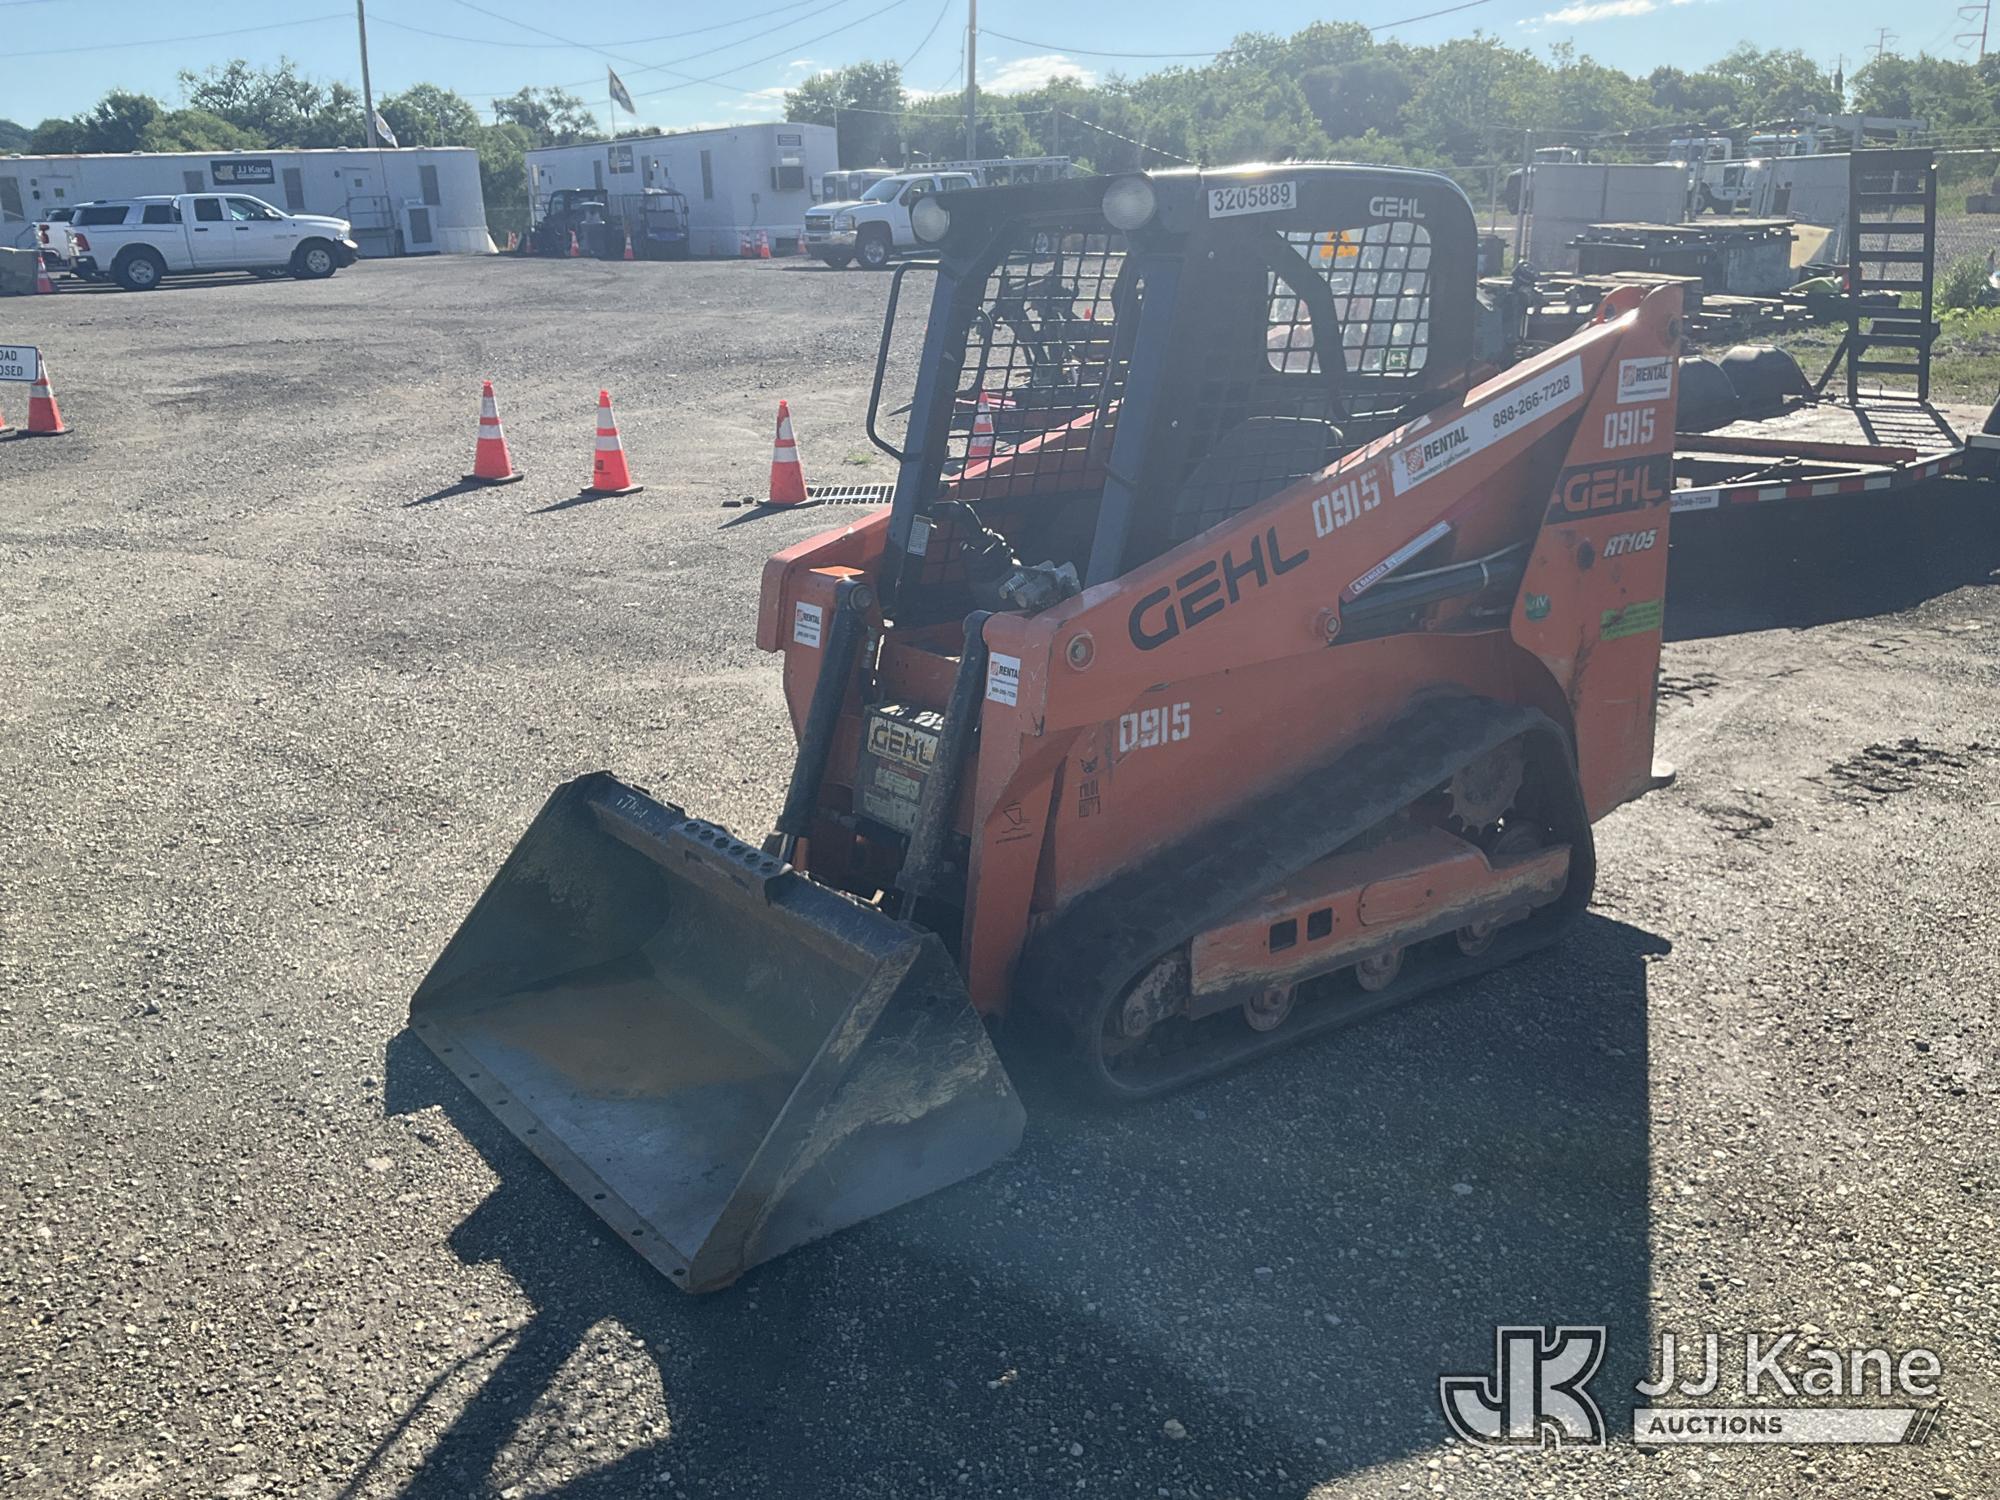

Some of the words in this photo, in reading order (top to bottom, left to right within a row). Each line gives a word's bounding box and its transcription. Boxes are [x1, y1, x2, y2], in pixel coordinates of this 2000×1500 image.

[248, 165, 271, 174] Kane
[1213, 183, 1291, 212] 3205889
[1369, 196, 1426, 218] GEHL
[1635, 365, 1668, 382] RENTAL
[1424, 427, 1469, 462] RENTAL
[1492, 375, 1571, 429] 888-266-7228
[1603, 408, 1656, 449] 0915
[1312, 468, 1382, 539] 0915
[1564, 465, 1662, 512] GEHL
[1128, 525, 1310, 651] GEHL
[999, 665, 1019, 679] RENTA
[872, 724, 934, 765] GEHL
[1118, 702, 1191, 753] 0915
